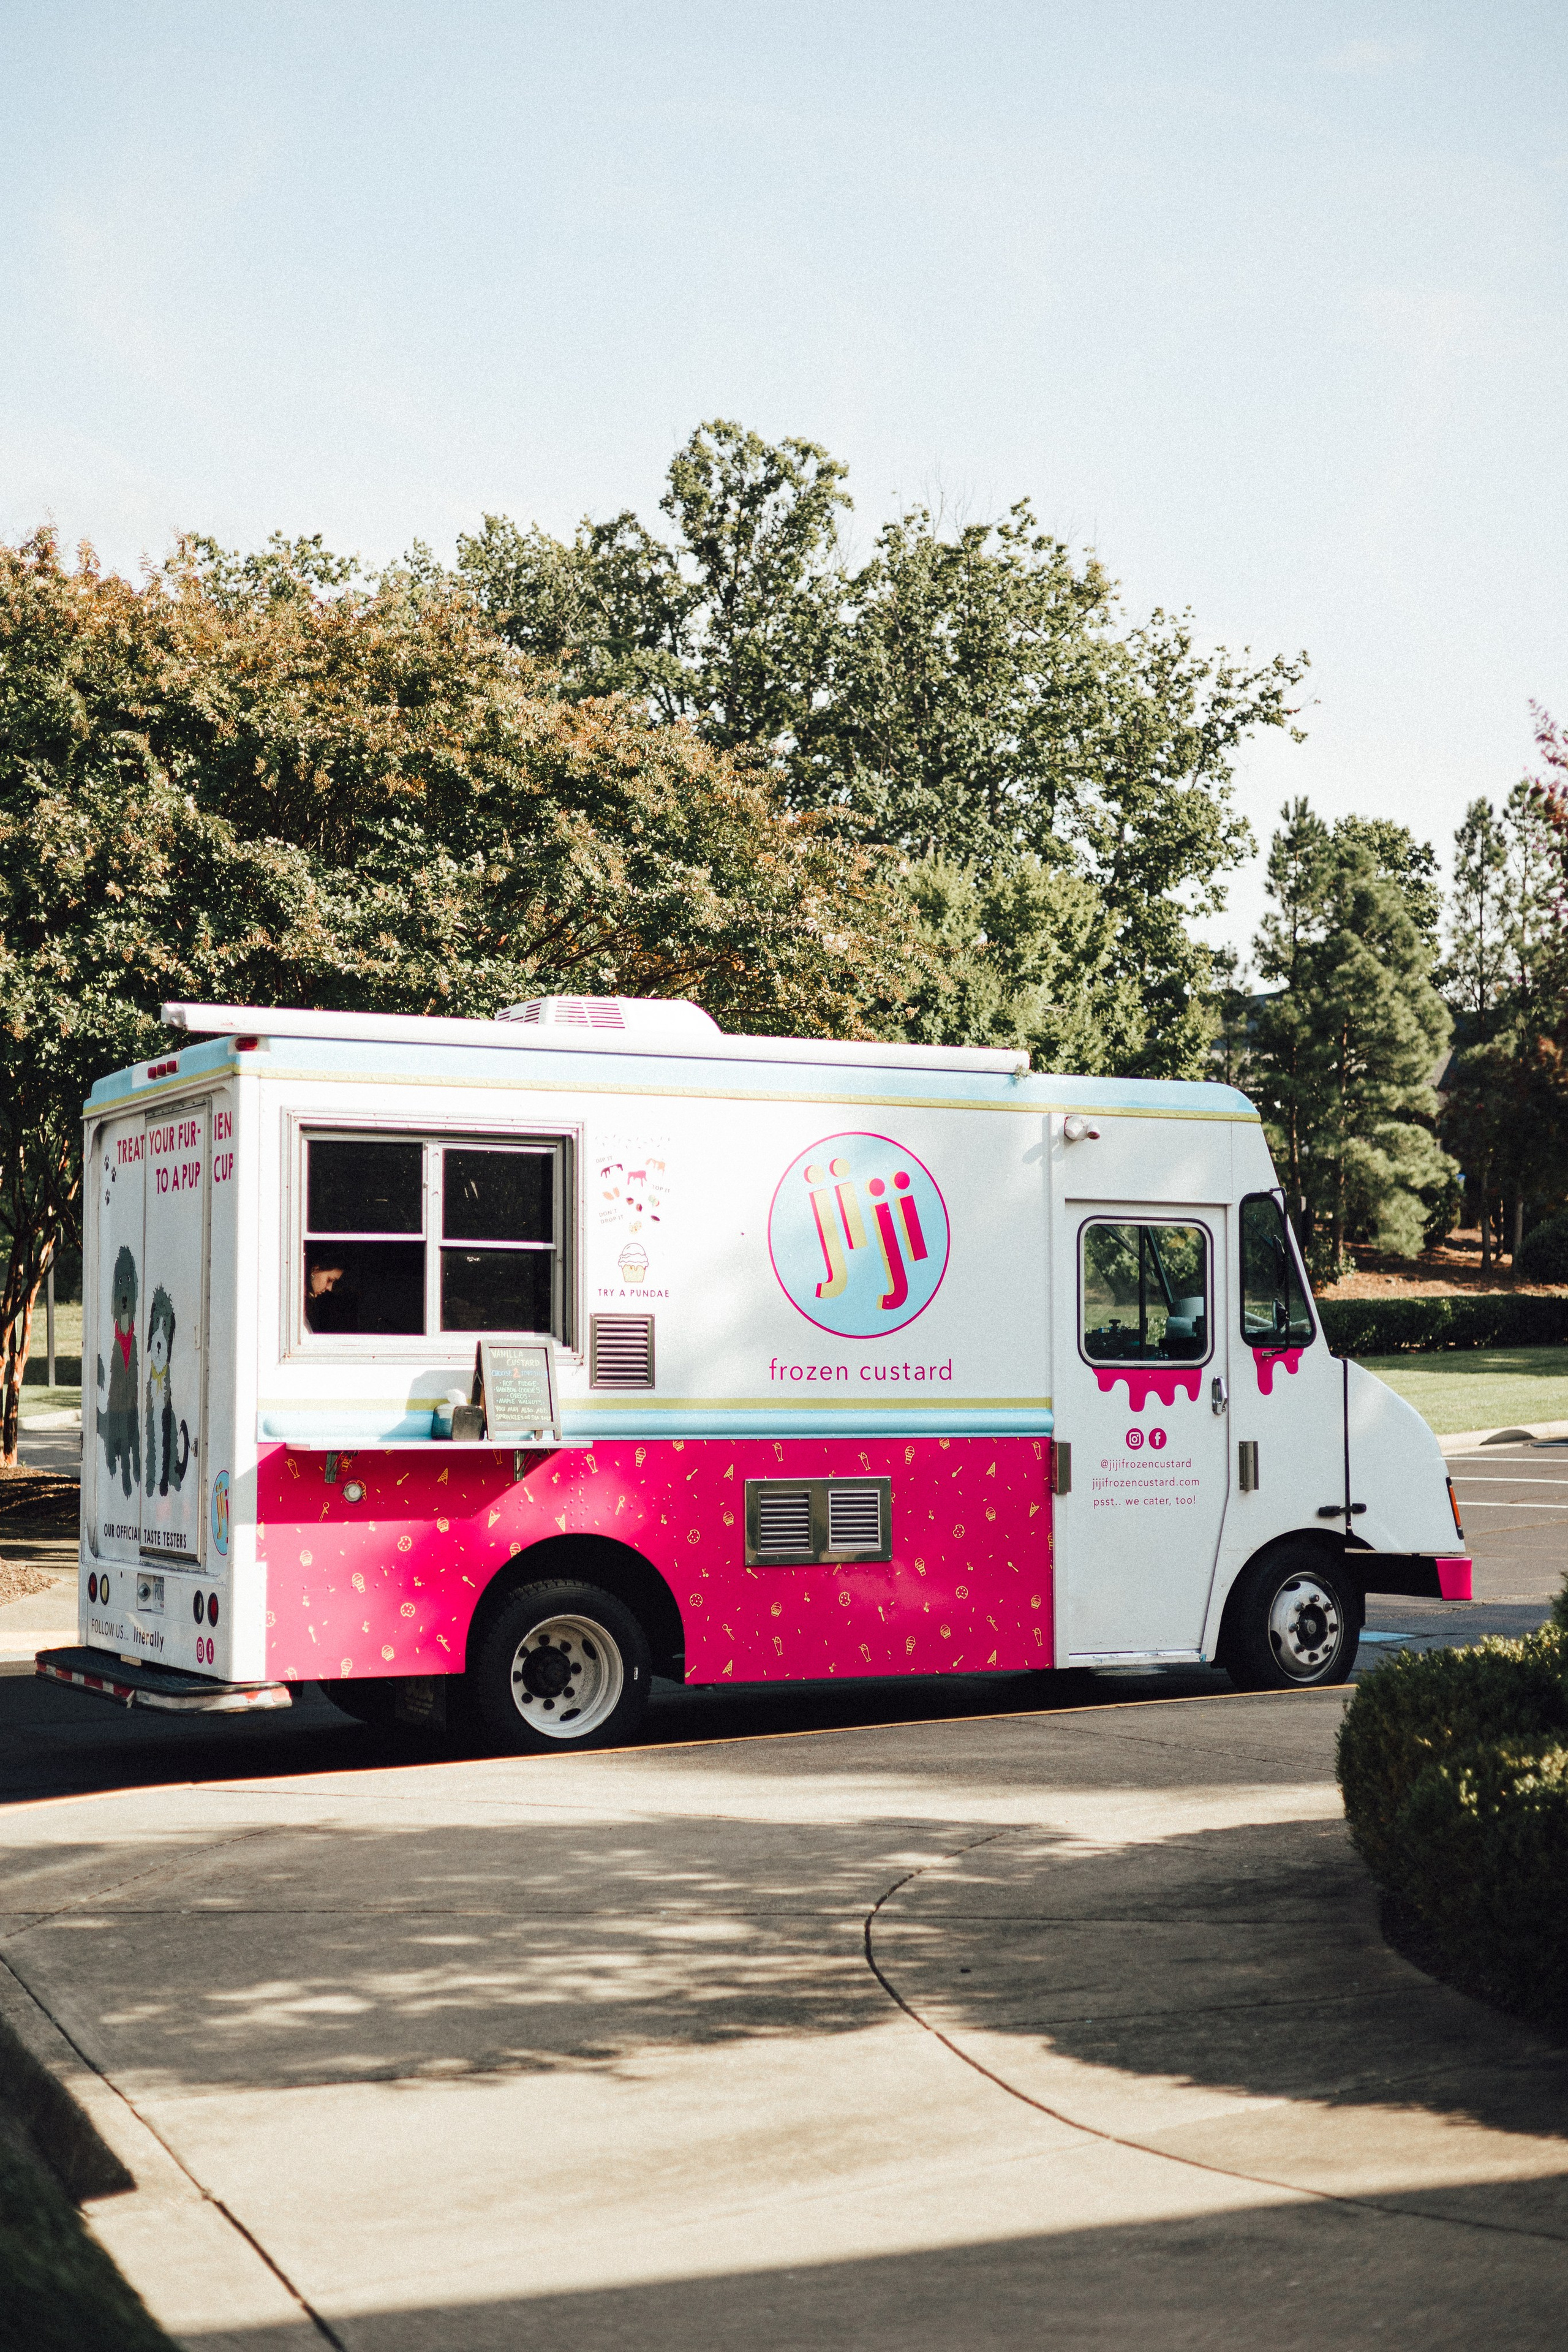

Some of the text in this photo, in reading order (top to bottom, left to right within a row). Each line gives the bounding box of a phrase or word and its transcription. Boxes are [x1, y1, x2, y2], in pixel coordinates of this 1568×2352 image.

[117, 1134, 145, 1164] TREAT
[149, 1126, 175, 1156] YOUR
[178, 1121, 201, 1150] FUR-
[156, 1153, 233, 1194] TO A PUP CUP
[804, 1158, 929, 1310] jiji
[490, 1349, 524, 1359] VANILLA
[769, 1358, 952, 1381] frozen custard
[1100, 1458, 1191, 1471] @jijifrozencustard
[1092, 1477, 1200, 1490] jijifrozencustard.com
[1093, 1498, 1121, 1509] psst..
[1144, 1496, 1171, 1506] cater,
[1175, 1494, 1196, 1504] too!
[104, 1523, 115, 1537] OUR
[144, 1529, 160, 1545] TASTE
[163, 1531, 187, 1549] TESTERS
[91, 1618, 115, 1637] FOLLOW
[134, 1626, 164, 1653] literally
